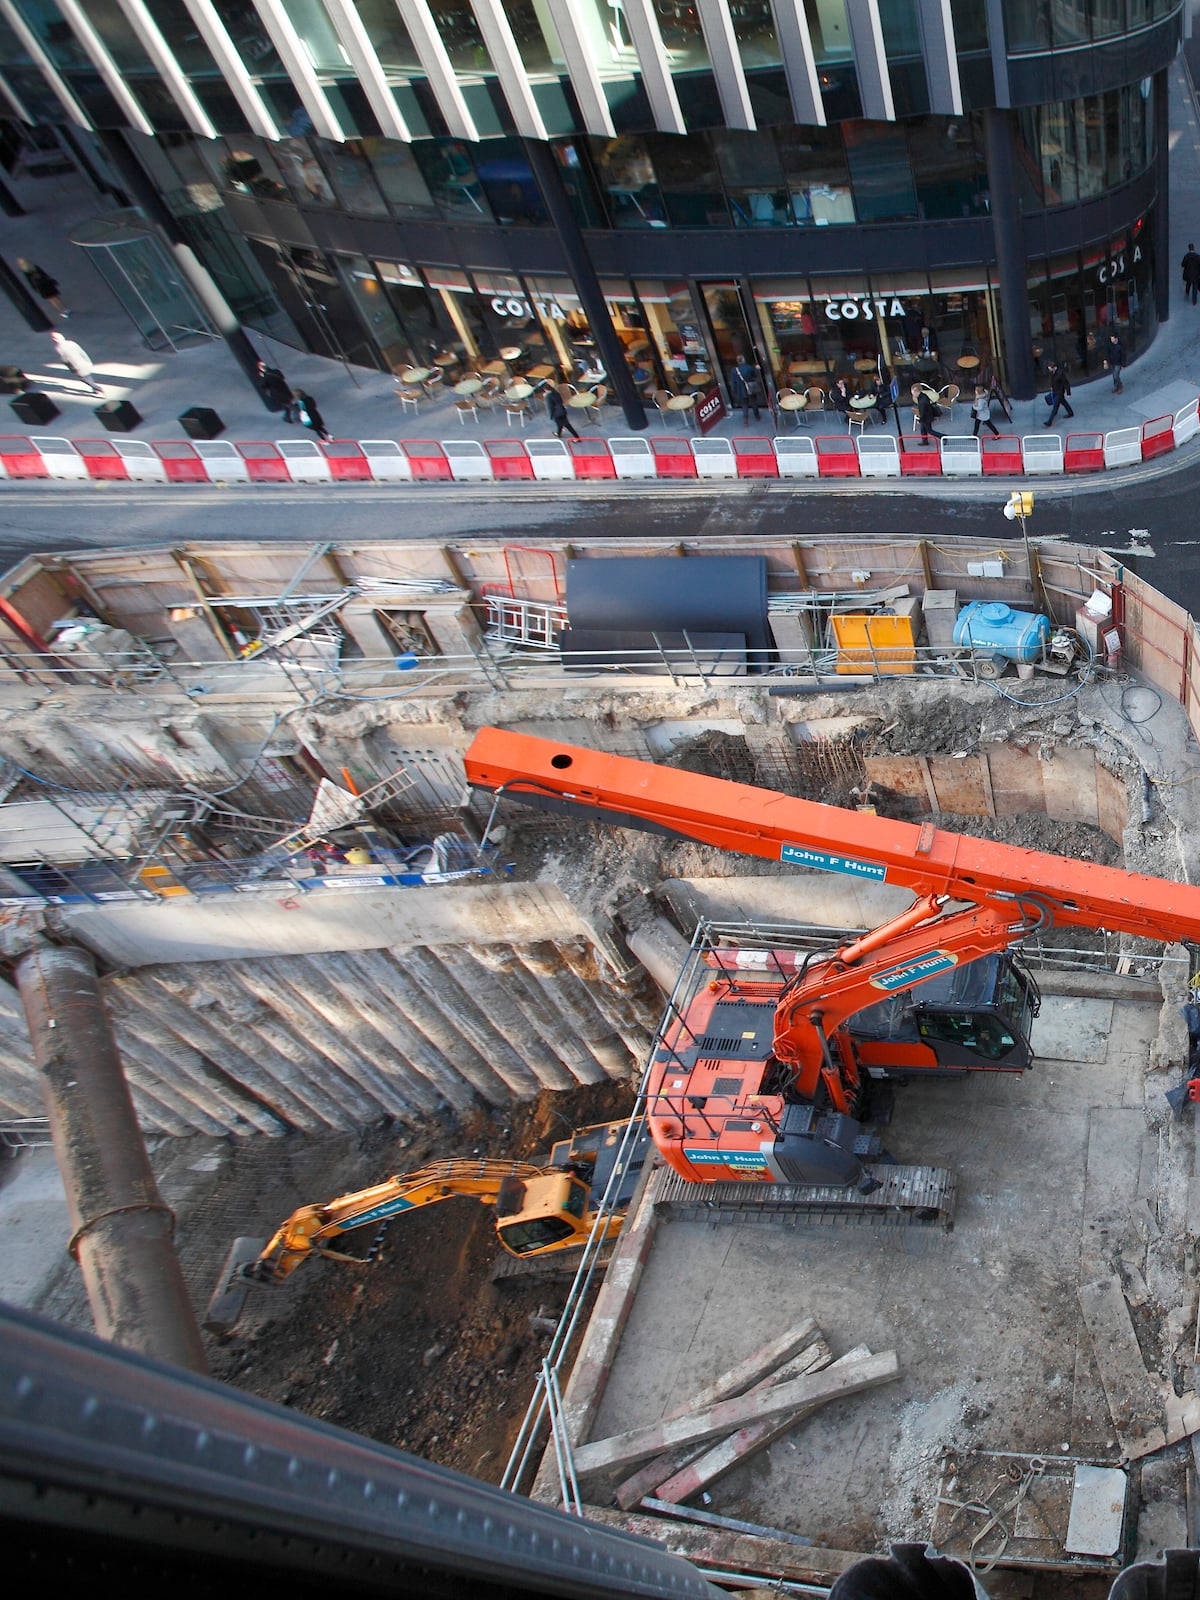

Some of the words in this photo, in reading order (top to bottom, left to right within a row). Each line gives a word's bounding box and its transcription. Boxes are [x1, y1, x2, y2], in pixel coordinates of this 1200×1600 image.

[1100, 246, 1142, 283] COSA
[825, 299, 906, 320] COSTA
[699, 396, 720, 418] COSTA
[784, 848, 824, 863] John
[829, 857, 840, 865] F
[844, 861, 884, 876] Hunt
[689, 1153, 720, 1161] John
[734, 1155, 766, 1163] Hunt
